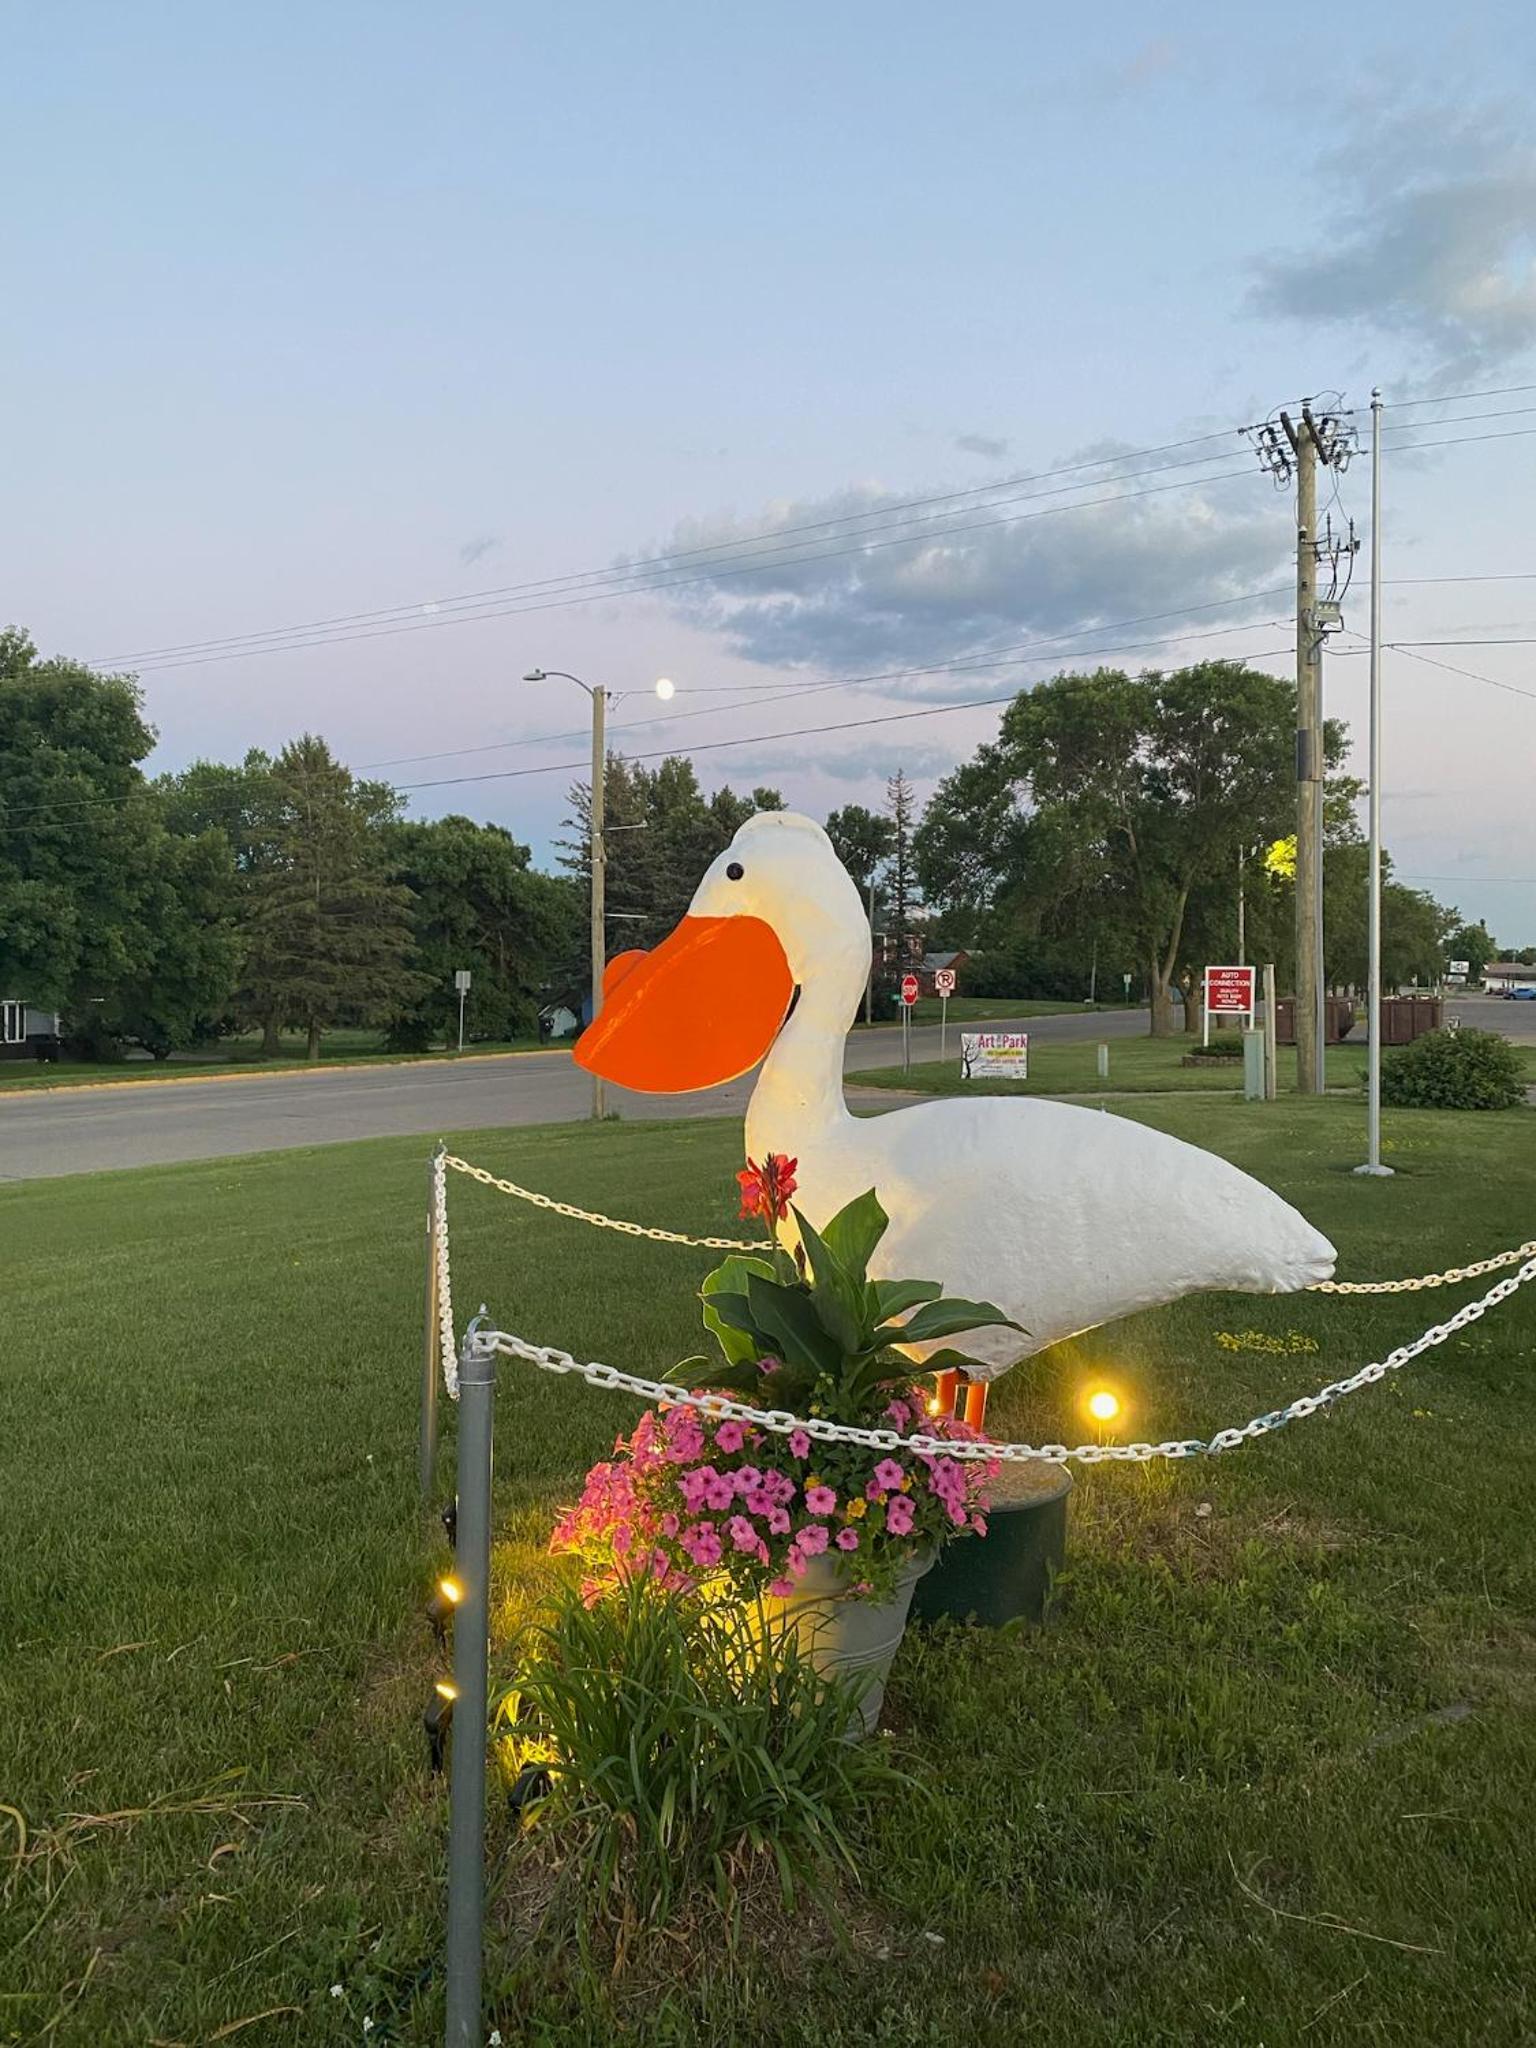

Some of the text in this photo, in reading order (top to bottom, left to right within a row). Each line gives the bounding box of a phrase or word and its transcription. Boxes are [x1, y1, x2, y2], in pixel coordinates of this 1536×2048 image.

[1220, 971, 1239, 979] AUTO
[1209, 979, 1250, 987] CONNECTION
[903, 985, 917, 995] STOP
[978, 1034, 995, 1048] Art
[1003, 1034, 1026, 1048] Park
